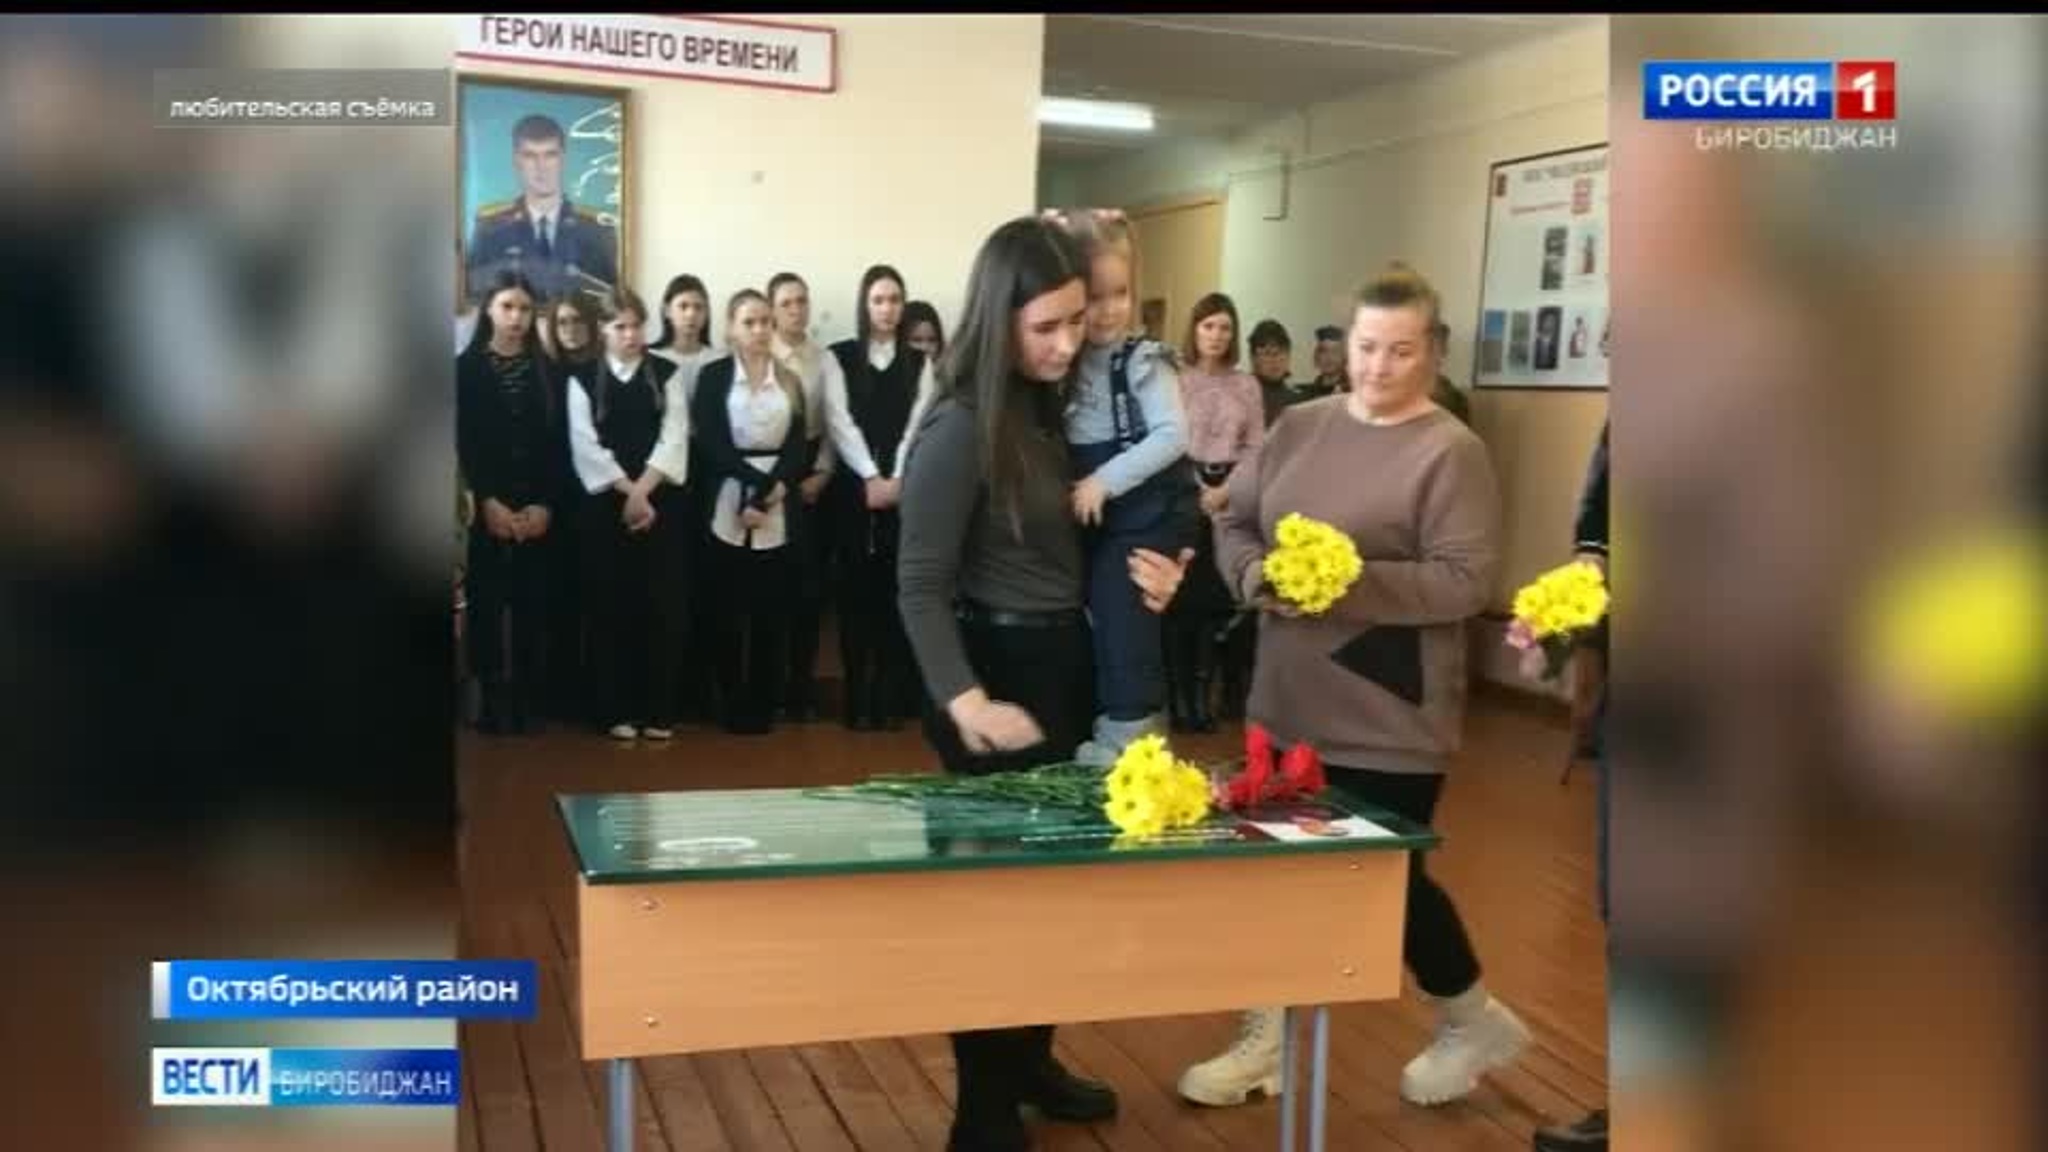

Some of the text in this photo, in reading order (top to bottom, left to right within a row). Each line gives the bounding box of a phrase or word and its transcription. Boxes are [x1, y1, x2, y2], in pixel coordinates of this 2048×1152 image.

[480, 16, 799, 73] ГЕРОИ НАШЕГО ВРЕМЕНИ
